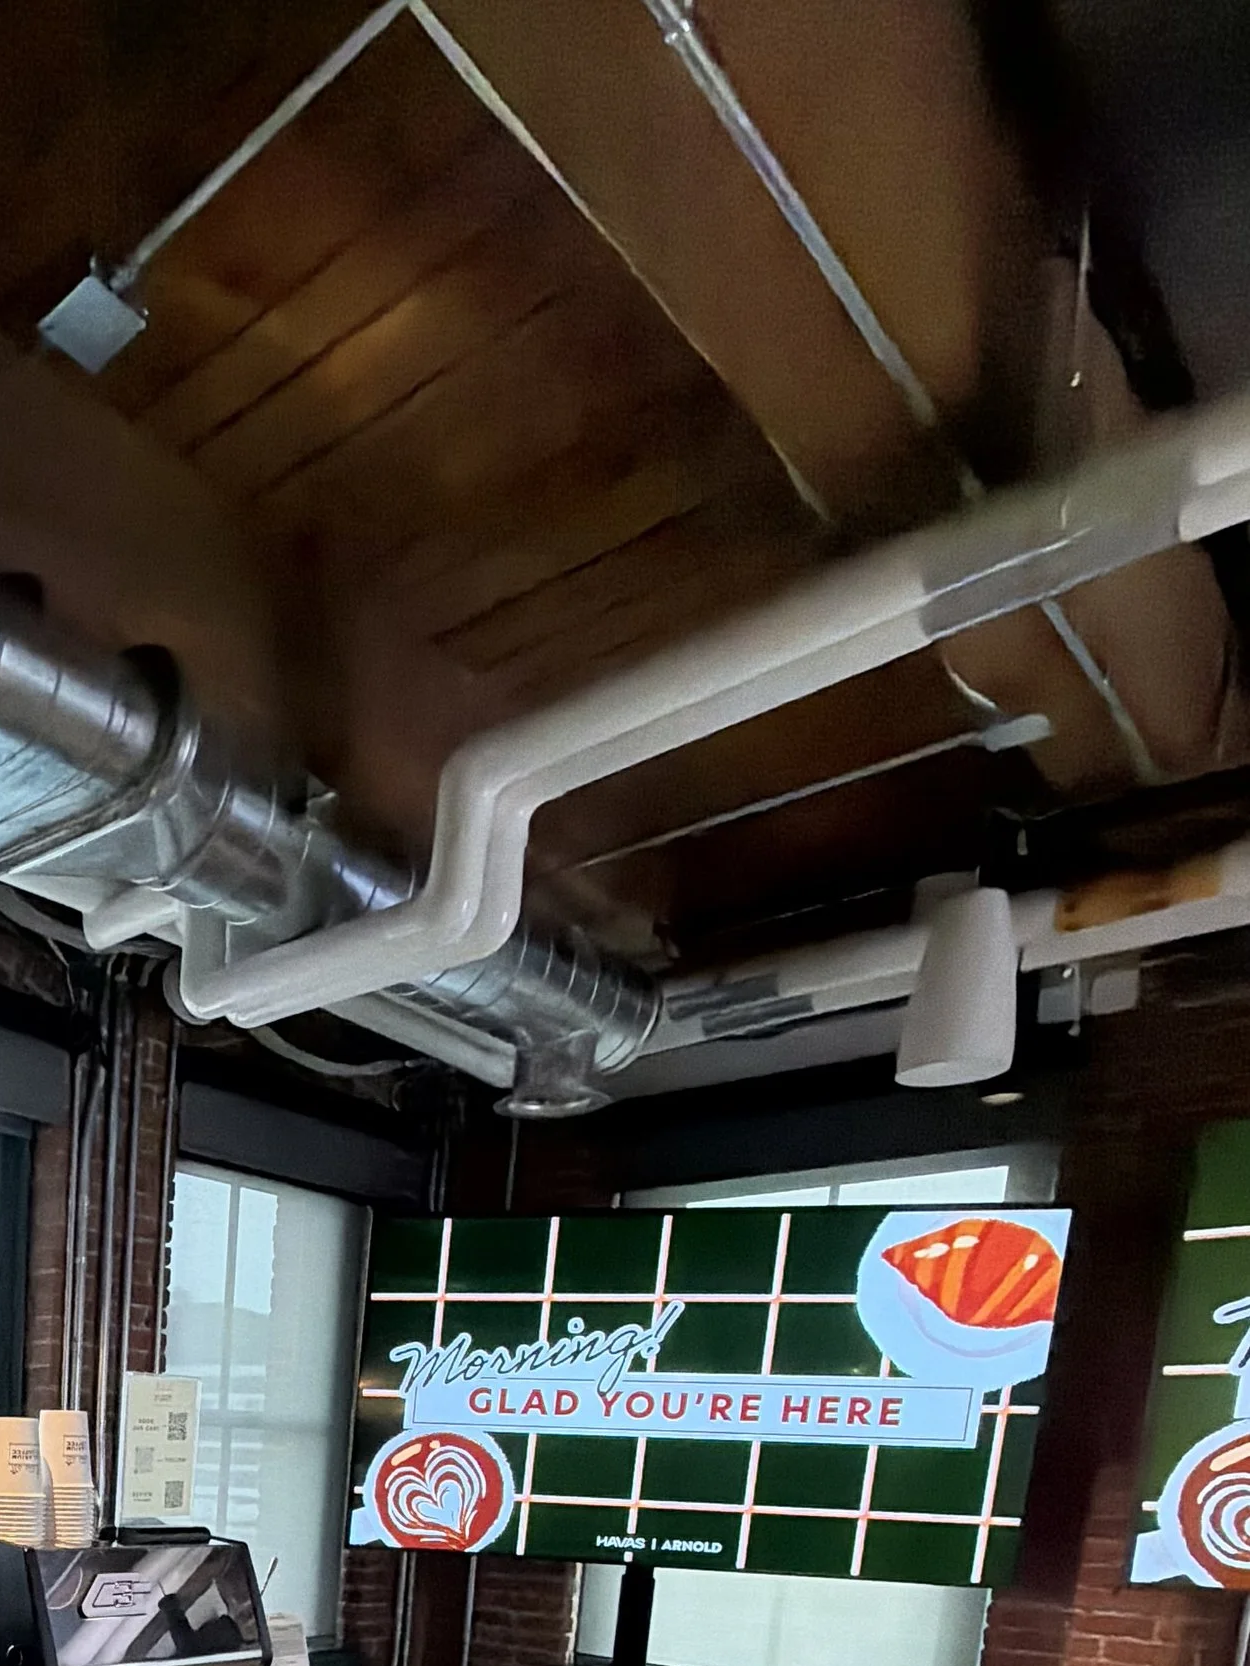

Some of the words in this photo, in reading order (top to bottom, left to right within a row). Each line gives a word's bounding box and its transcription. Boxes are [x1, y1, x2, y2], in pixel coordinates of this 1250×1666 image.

[392, 1303, 680, 1395] Morning!
[468, 1387, 580, 1416] GLAD
[600, 1389, 762, 1422] YOU'RE
[781, 1395, 903, 1426] HERE
[596, 1535, 646, 1549] HAVAS
[660, 1539, 723, 1554] ARNOLD
